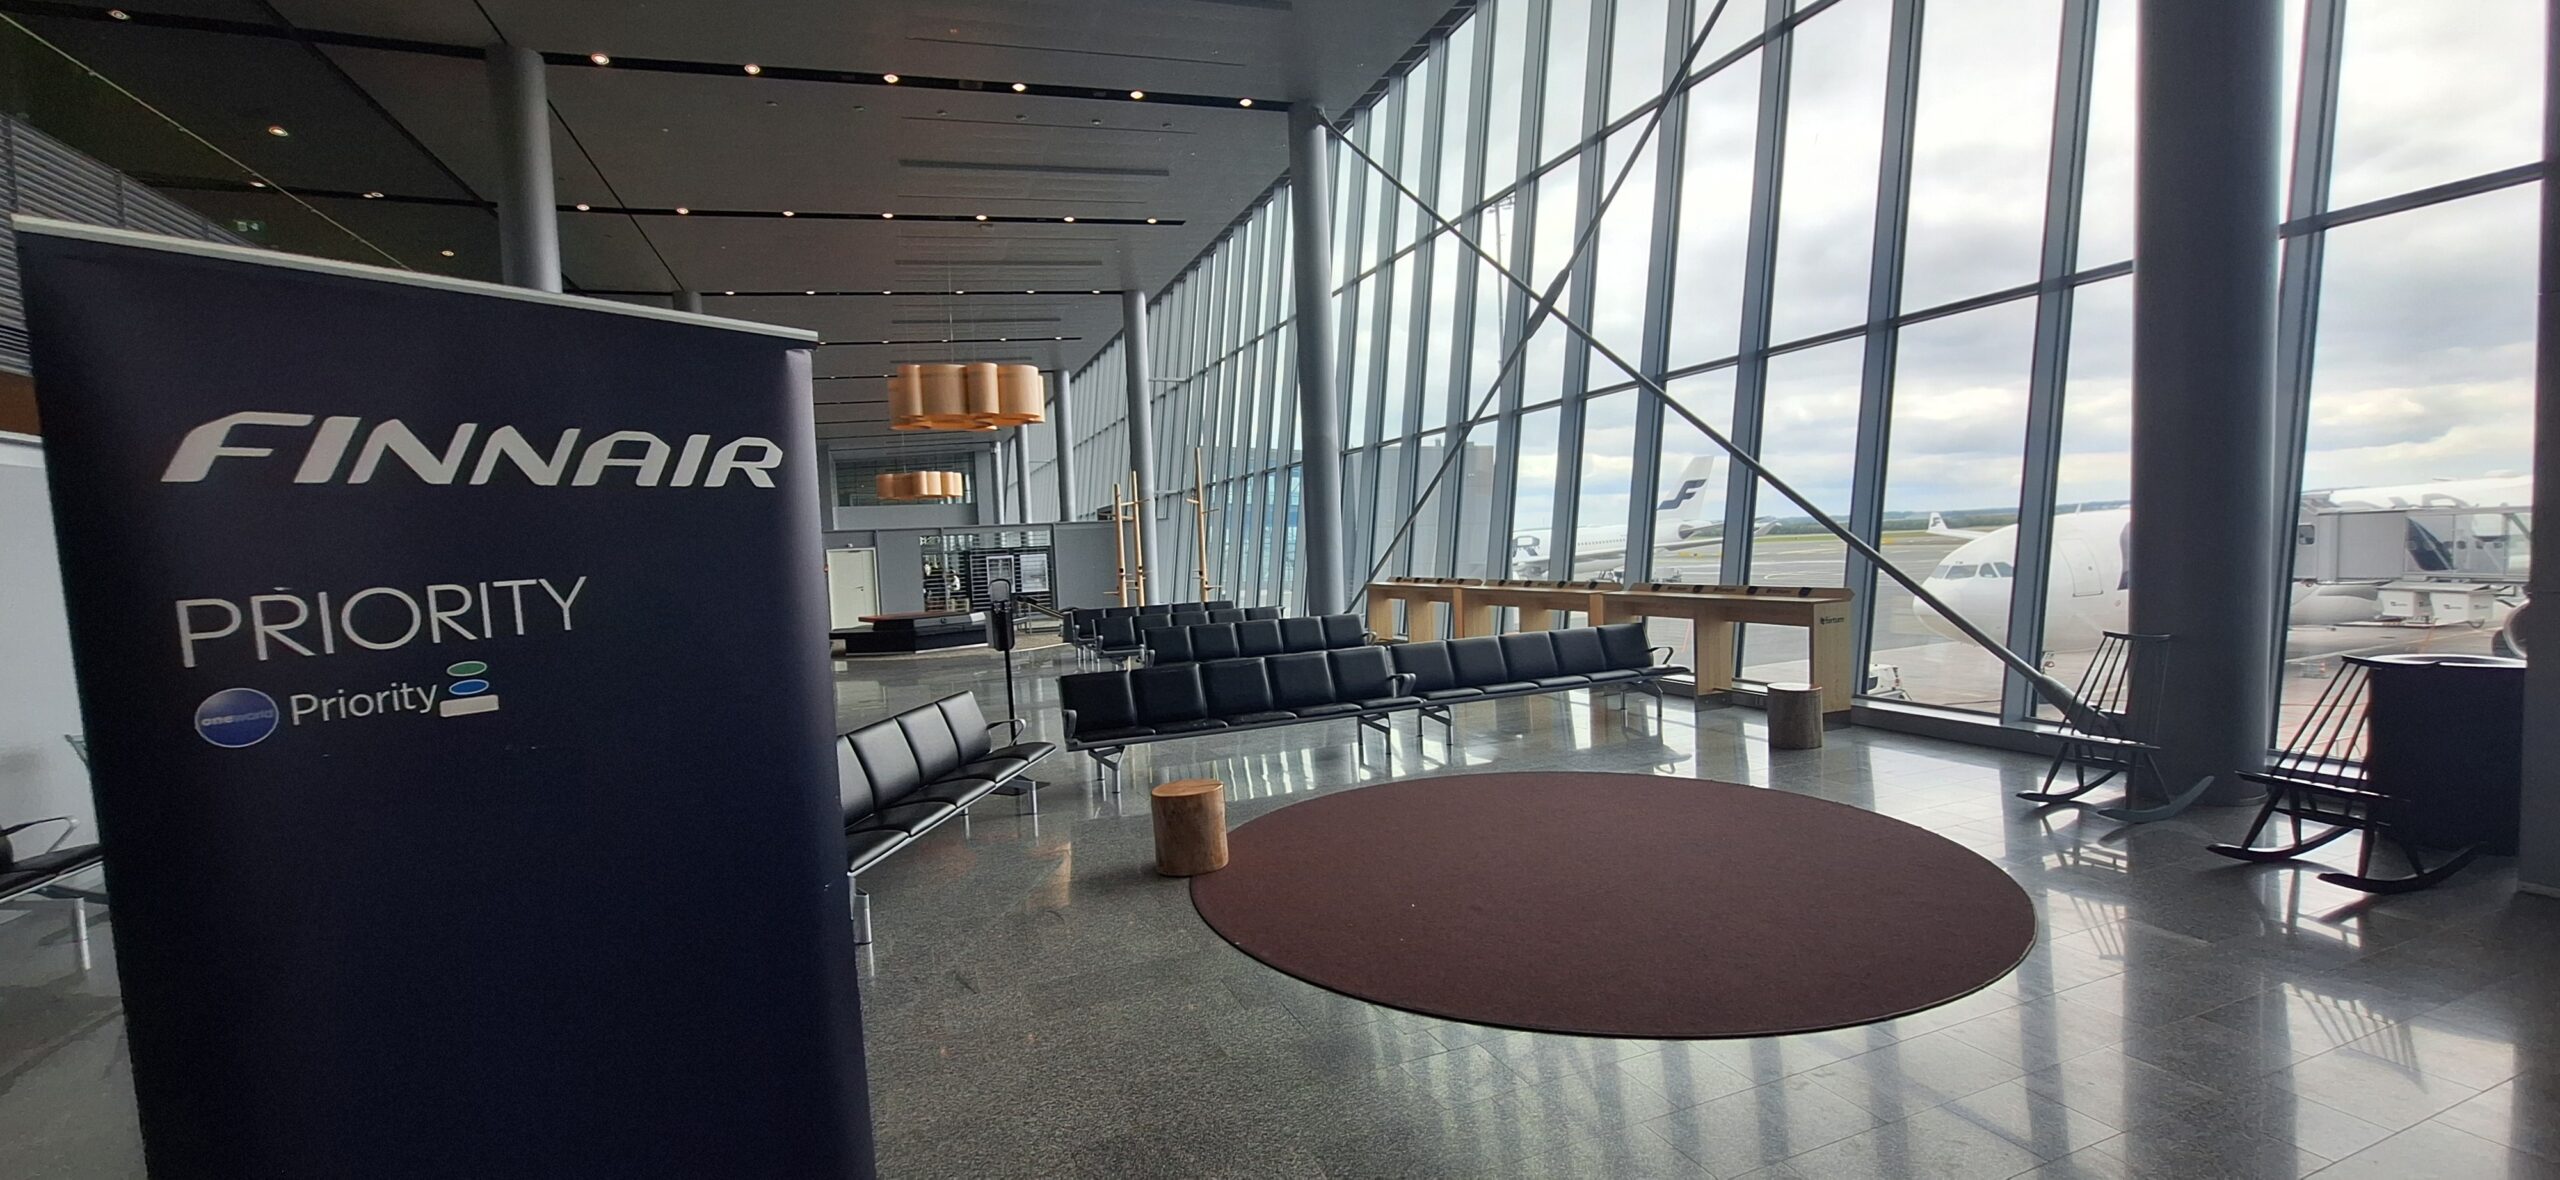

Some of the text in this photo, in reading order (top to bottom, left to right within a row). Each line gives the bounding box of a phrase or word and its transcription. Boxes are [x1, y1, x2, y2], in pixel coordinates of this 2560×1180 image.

[161, 411, 784, 488] FINNAIR
[175, 576, 587, 668] PRIORITY
[201, 682, 438, 727] oneworld Priority
